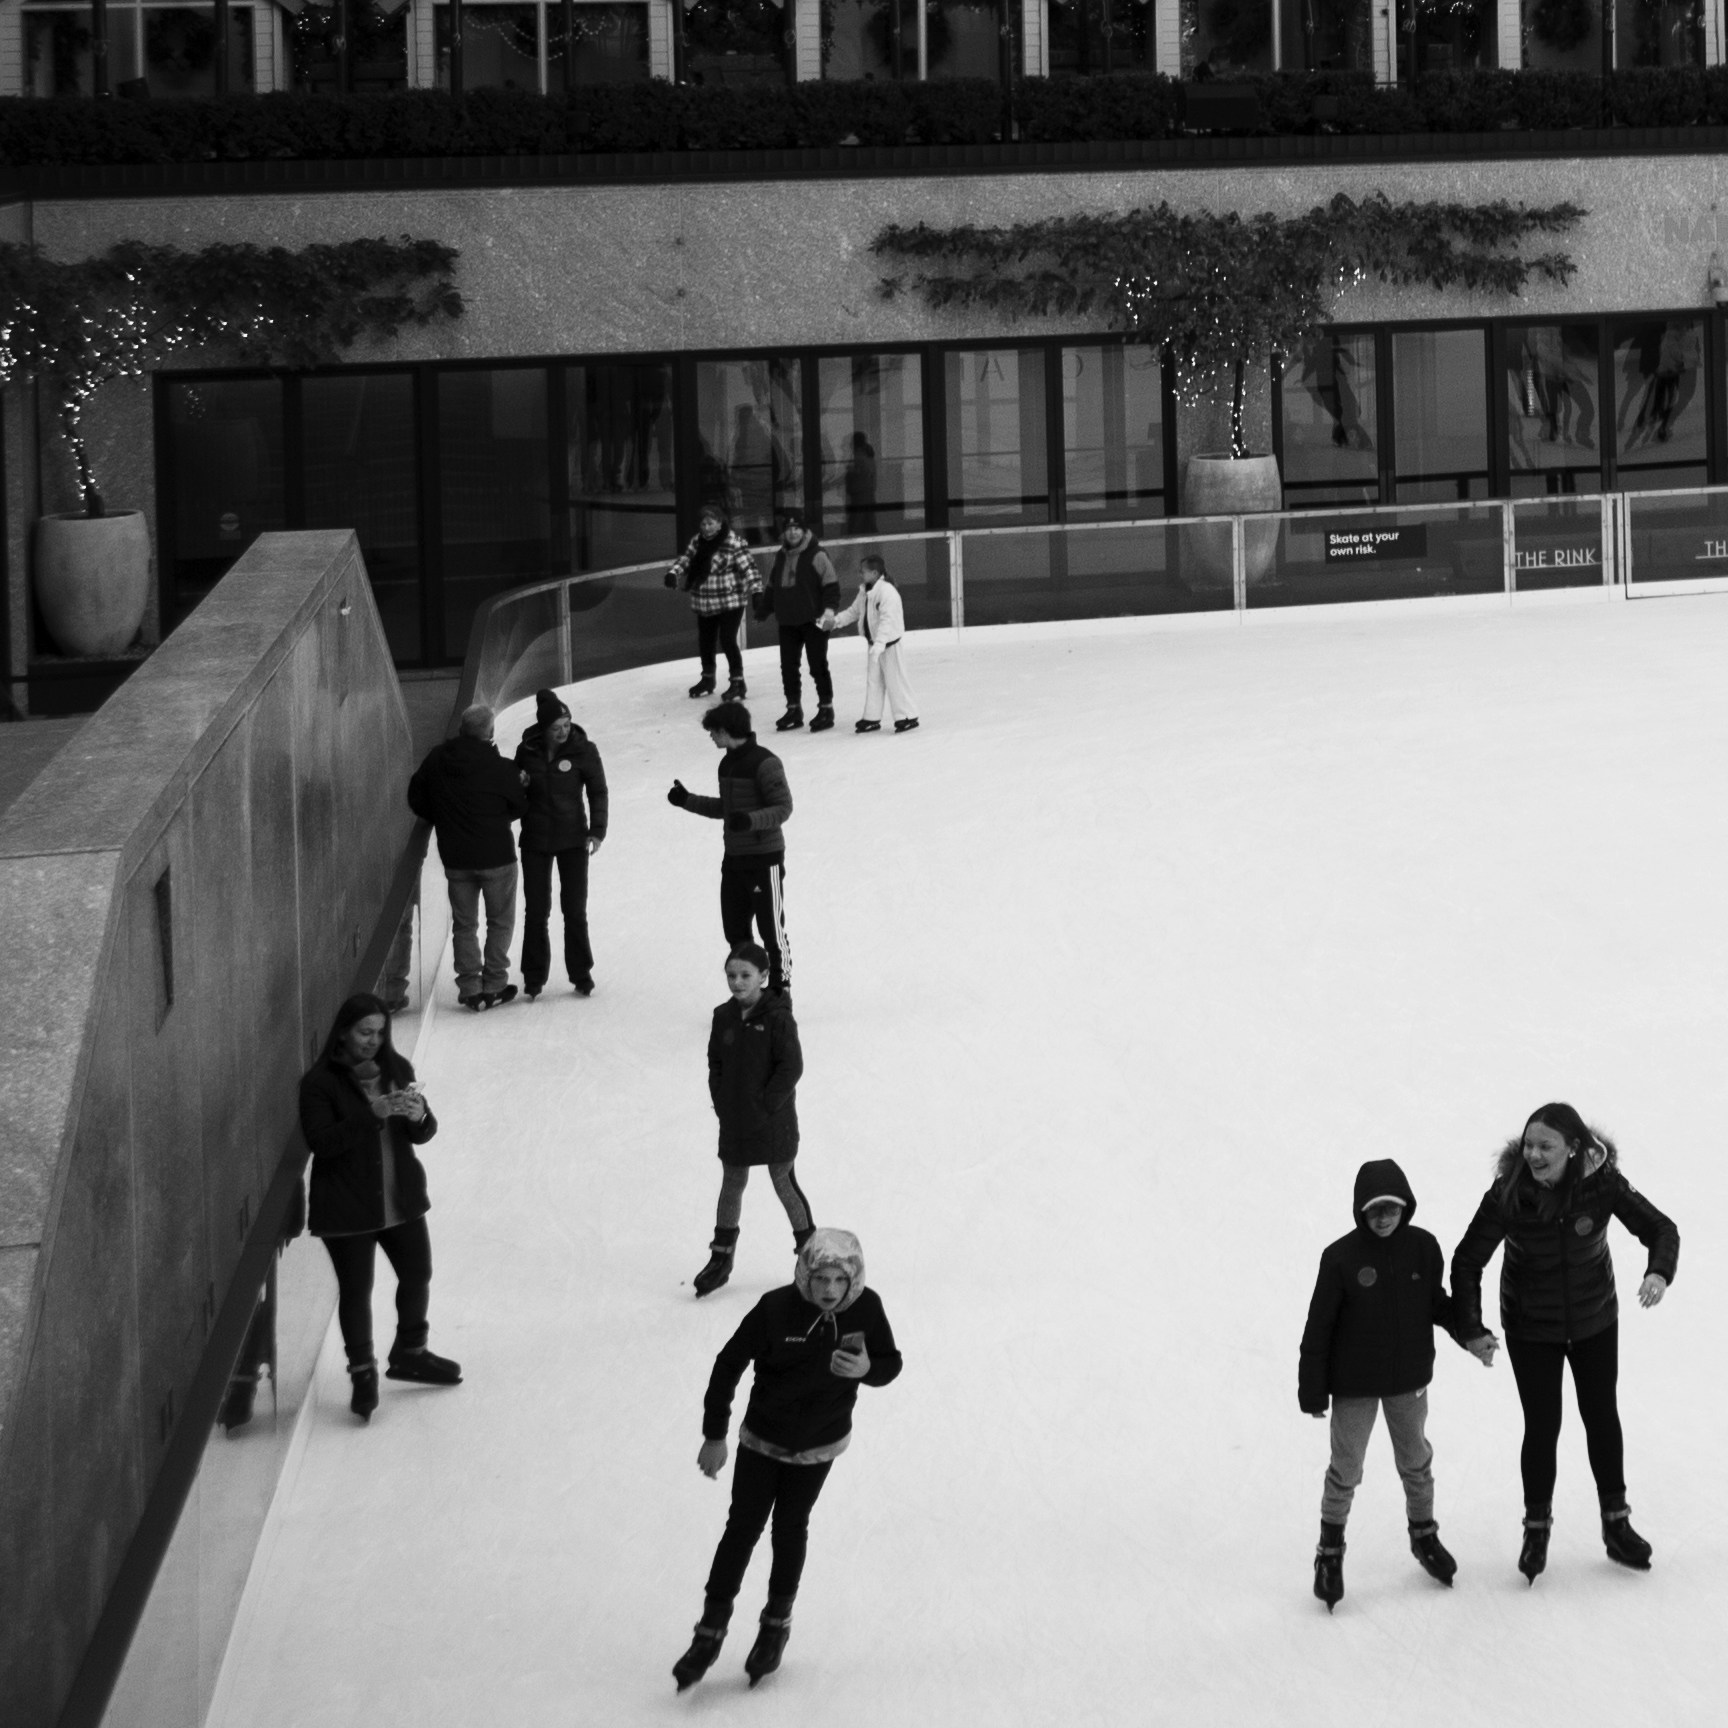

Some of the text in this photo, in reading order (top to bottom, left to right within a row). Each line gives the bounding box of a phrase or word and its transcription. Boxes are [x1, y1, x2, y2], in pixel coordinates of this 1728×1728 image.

[1329, 530, 1400, 546] Skate at your
[1329, 543, 1377, 558] own risk.
[1515, 548, 1596, 569] THE RINK
